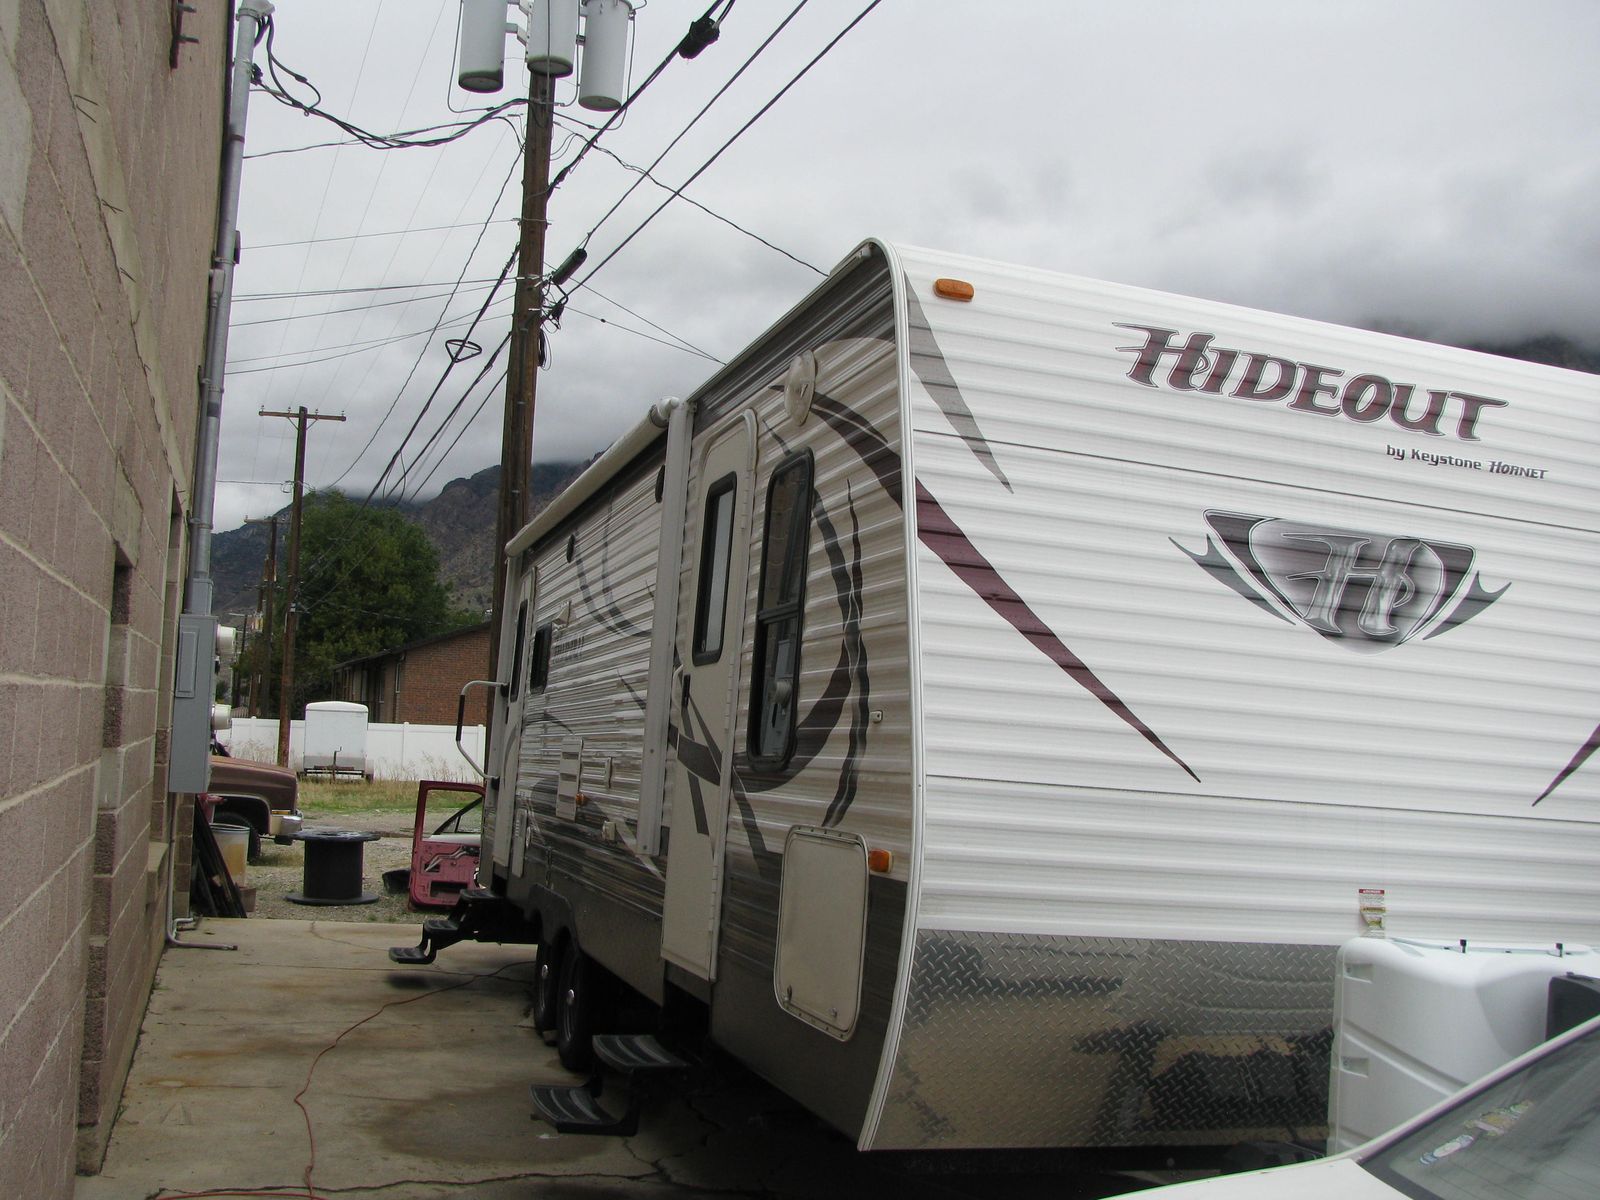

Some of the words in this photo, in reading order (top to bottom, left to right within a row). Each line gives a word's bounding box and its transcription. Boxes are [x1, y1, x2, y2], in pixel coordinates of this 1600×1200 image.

[1112, 322, 1509, 441] HIDEOUT
[1386, 444, 1406, 461] by
[1411, 448, 1482, 470] Keystone
[1488, 461, 1548, 479] HORNET
